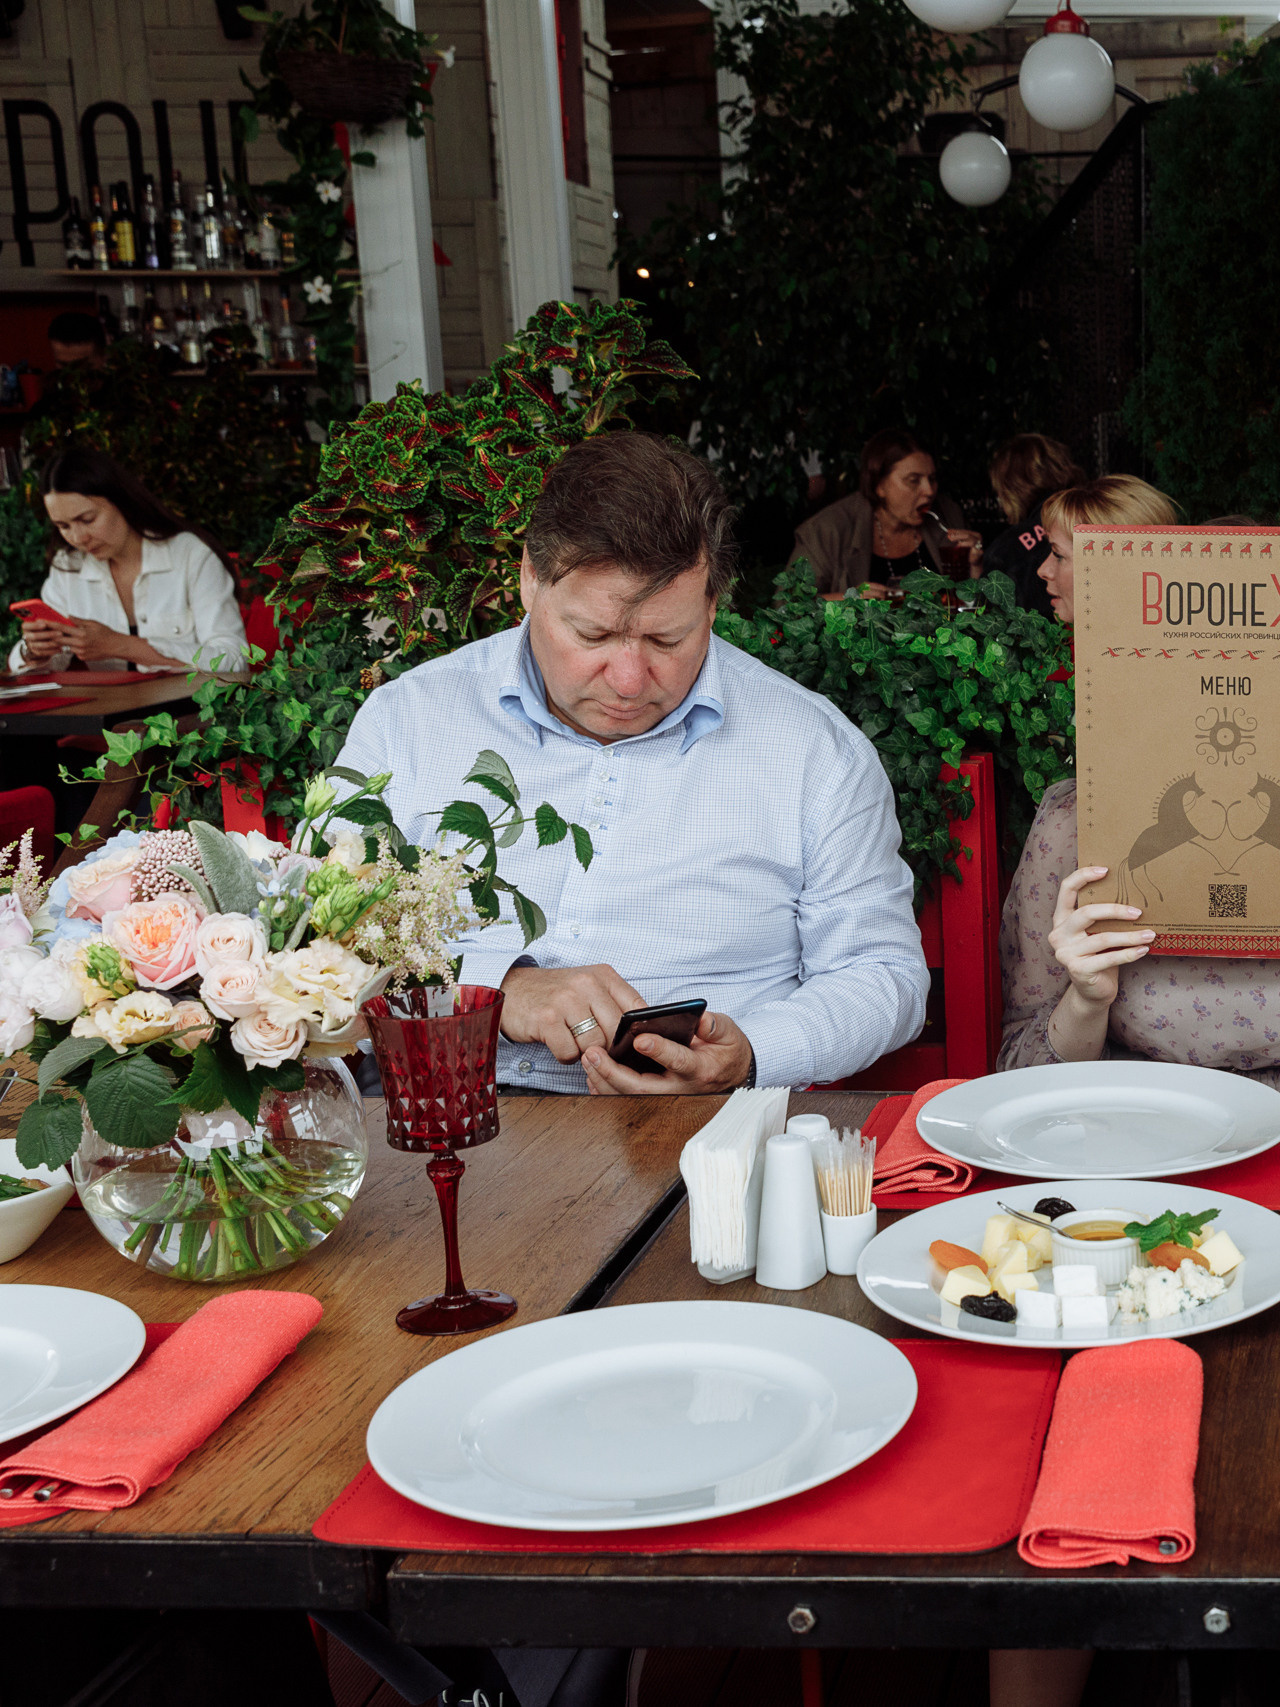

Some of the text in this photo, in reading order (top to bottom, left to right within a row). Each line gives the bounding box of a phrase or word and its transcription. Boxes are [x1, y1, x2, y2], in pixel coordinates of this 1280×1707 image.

[1163, 631, 1188, 640] КУХНЯ
[1190, 631, 1242, 640] РОССИЙСКИХ
[1200, 676, 1252, 696] МЕНЮ
